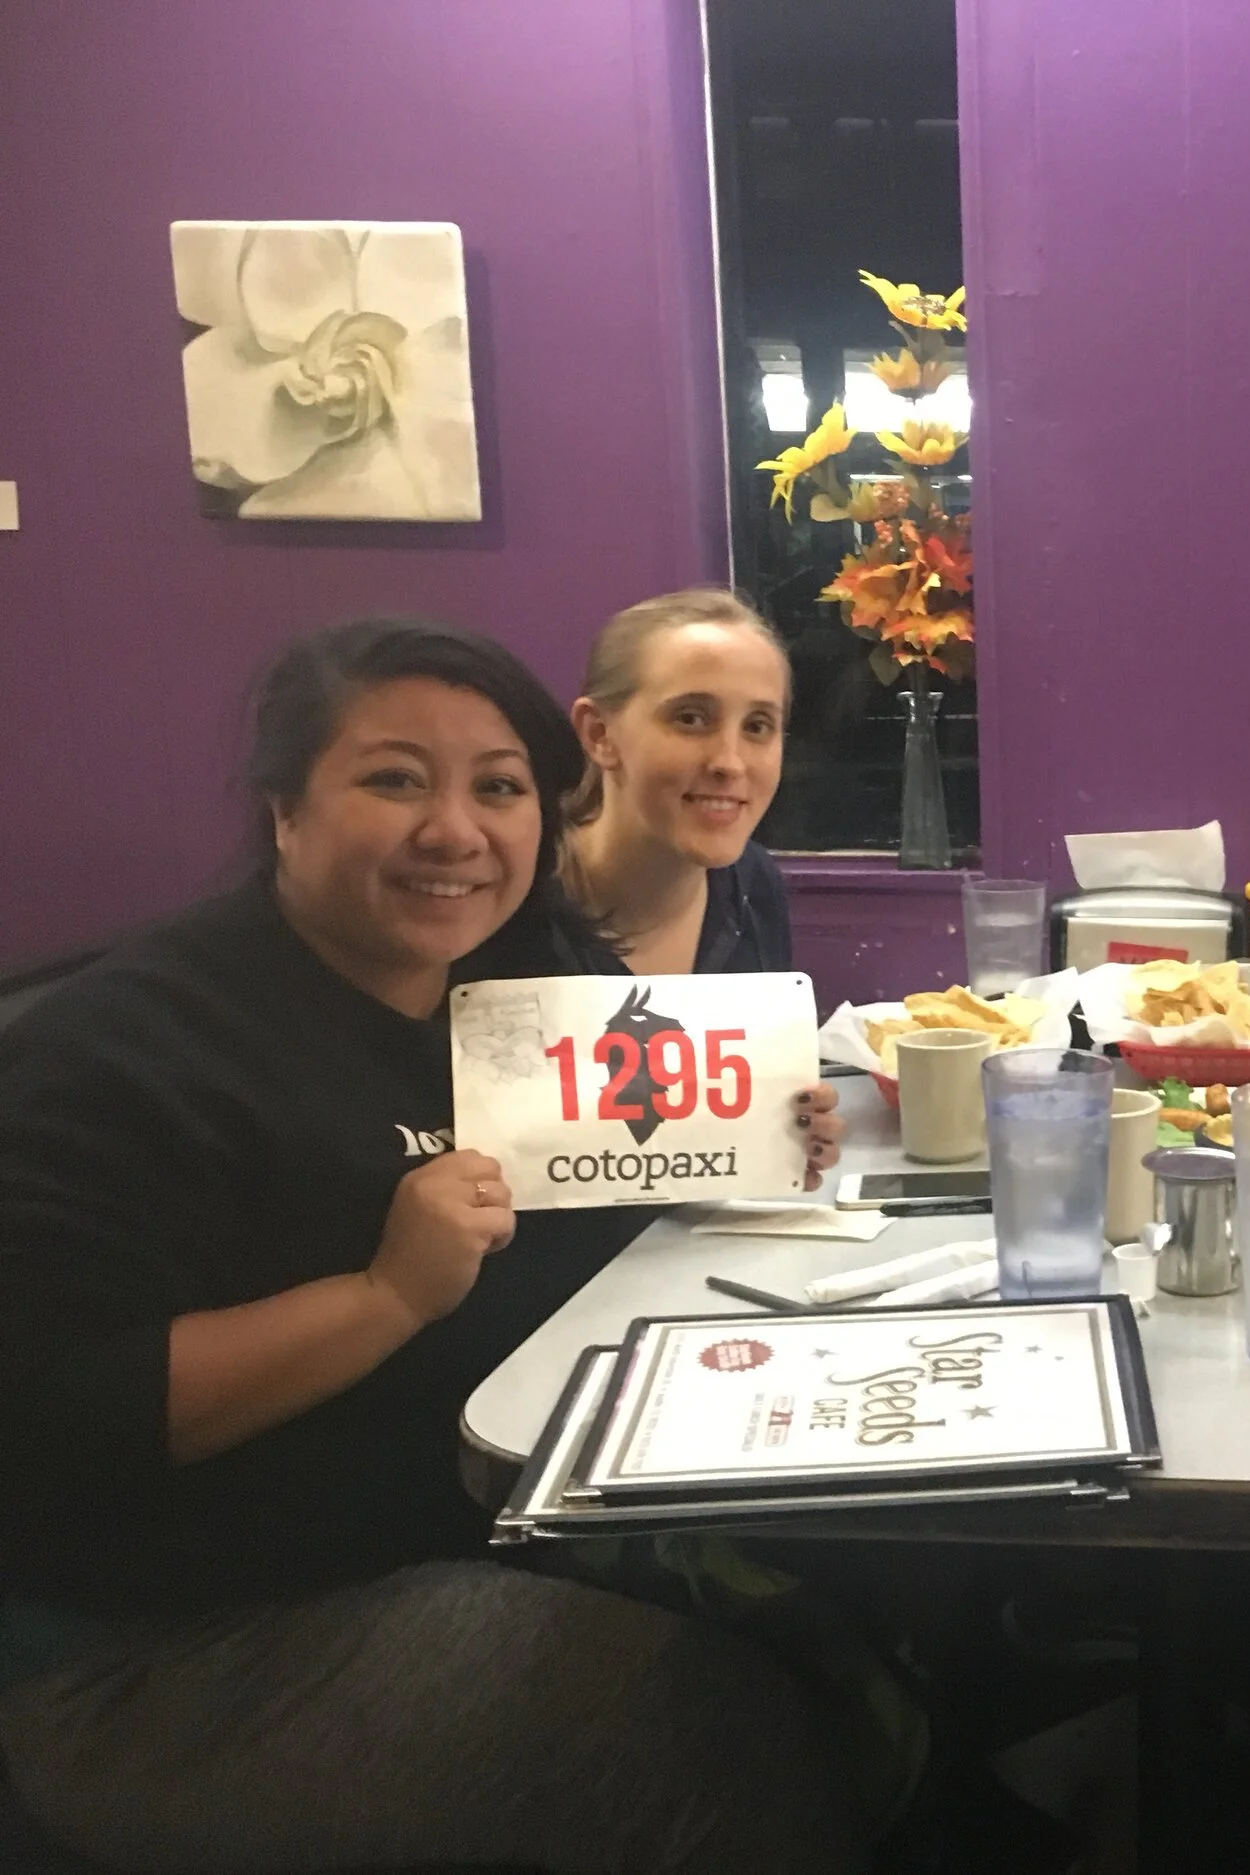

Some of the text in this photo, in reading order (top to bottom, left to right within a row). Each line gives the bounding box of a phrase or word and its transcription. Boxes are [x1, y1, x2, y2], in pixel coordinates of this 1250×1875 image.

[545, 1029, 752, 1121] 1295
[547, 1146, 738, 1190] cotopaxi
[906, 1332, 1004, 1390] Star
[808, 1398, 848, 1430] CAFE
[826, 1366, 947, 1447] Seeds
